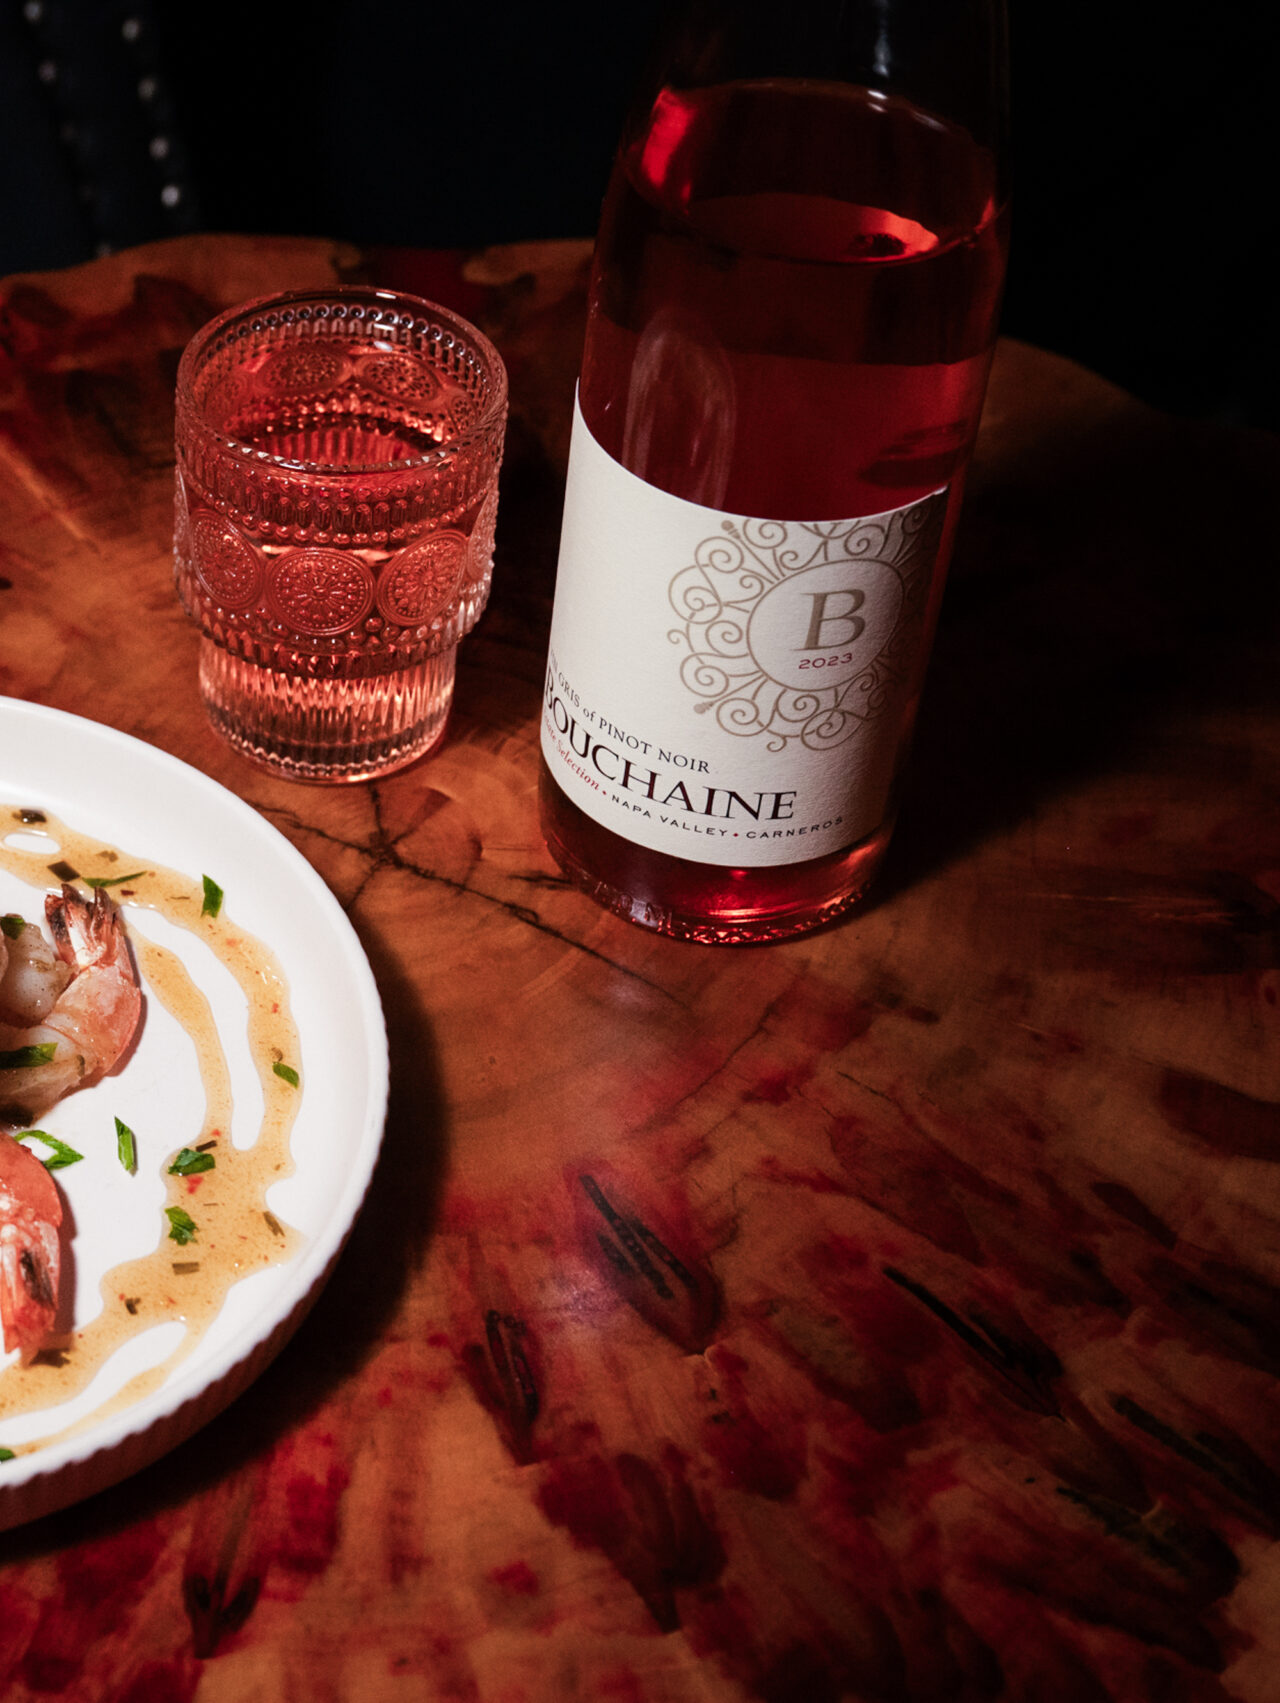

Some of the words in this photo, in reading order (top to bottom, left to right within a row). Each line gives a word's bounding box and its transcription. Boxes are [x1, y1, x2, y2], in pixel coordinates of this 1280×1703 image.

[790, 588, 866, 652] B
[798, 653, 853, 670] 2023
[545, 665, 797, 821] BOUCHAINE
[558, 672, 581, 708] GRIS
[583, 708, 597, 722] of
[599, 716, 652, 755] PINOT
[658, 748, 710, 774] NOIR
[556, 738, 599, 791] Selection
[612, 794, 651, 819] NAPA
[660, 815, 728, 837] VALLEY
[746, 816, 843, 839] CARNEROS
